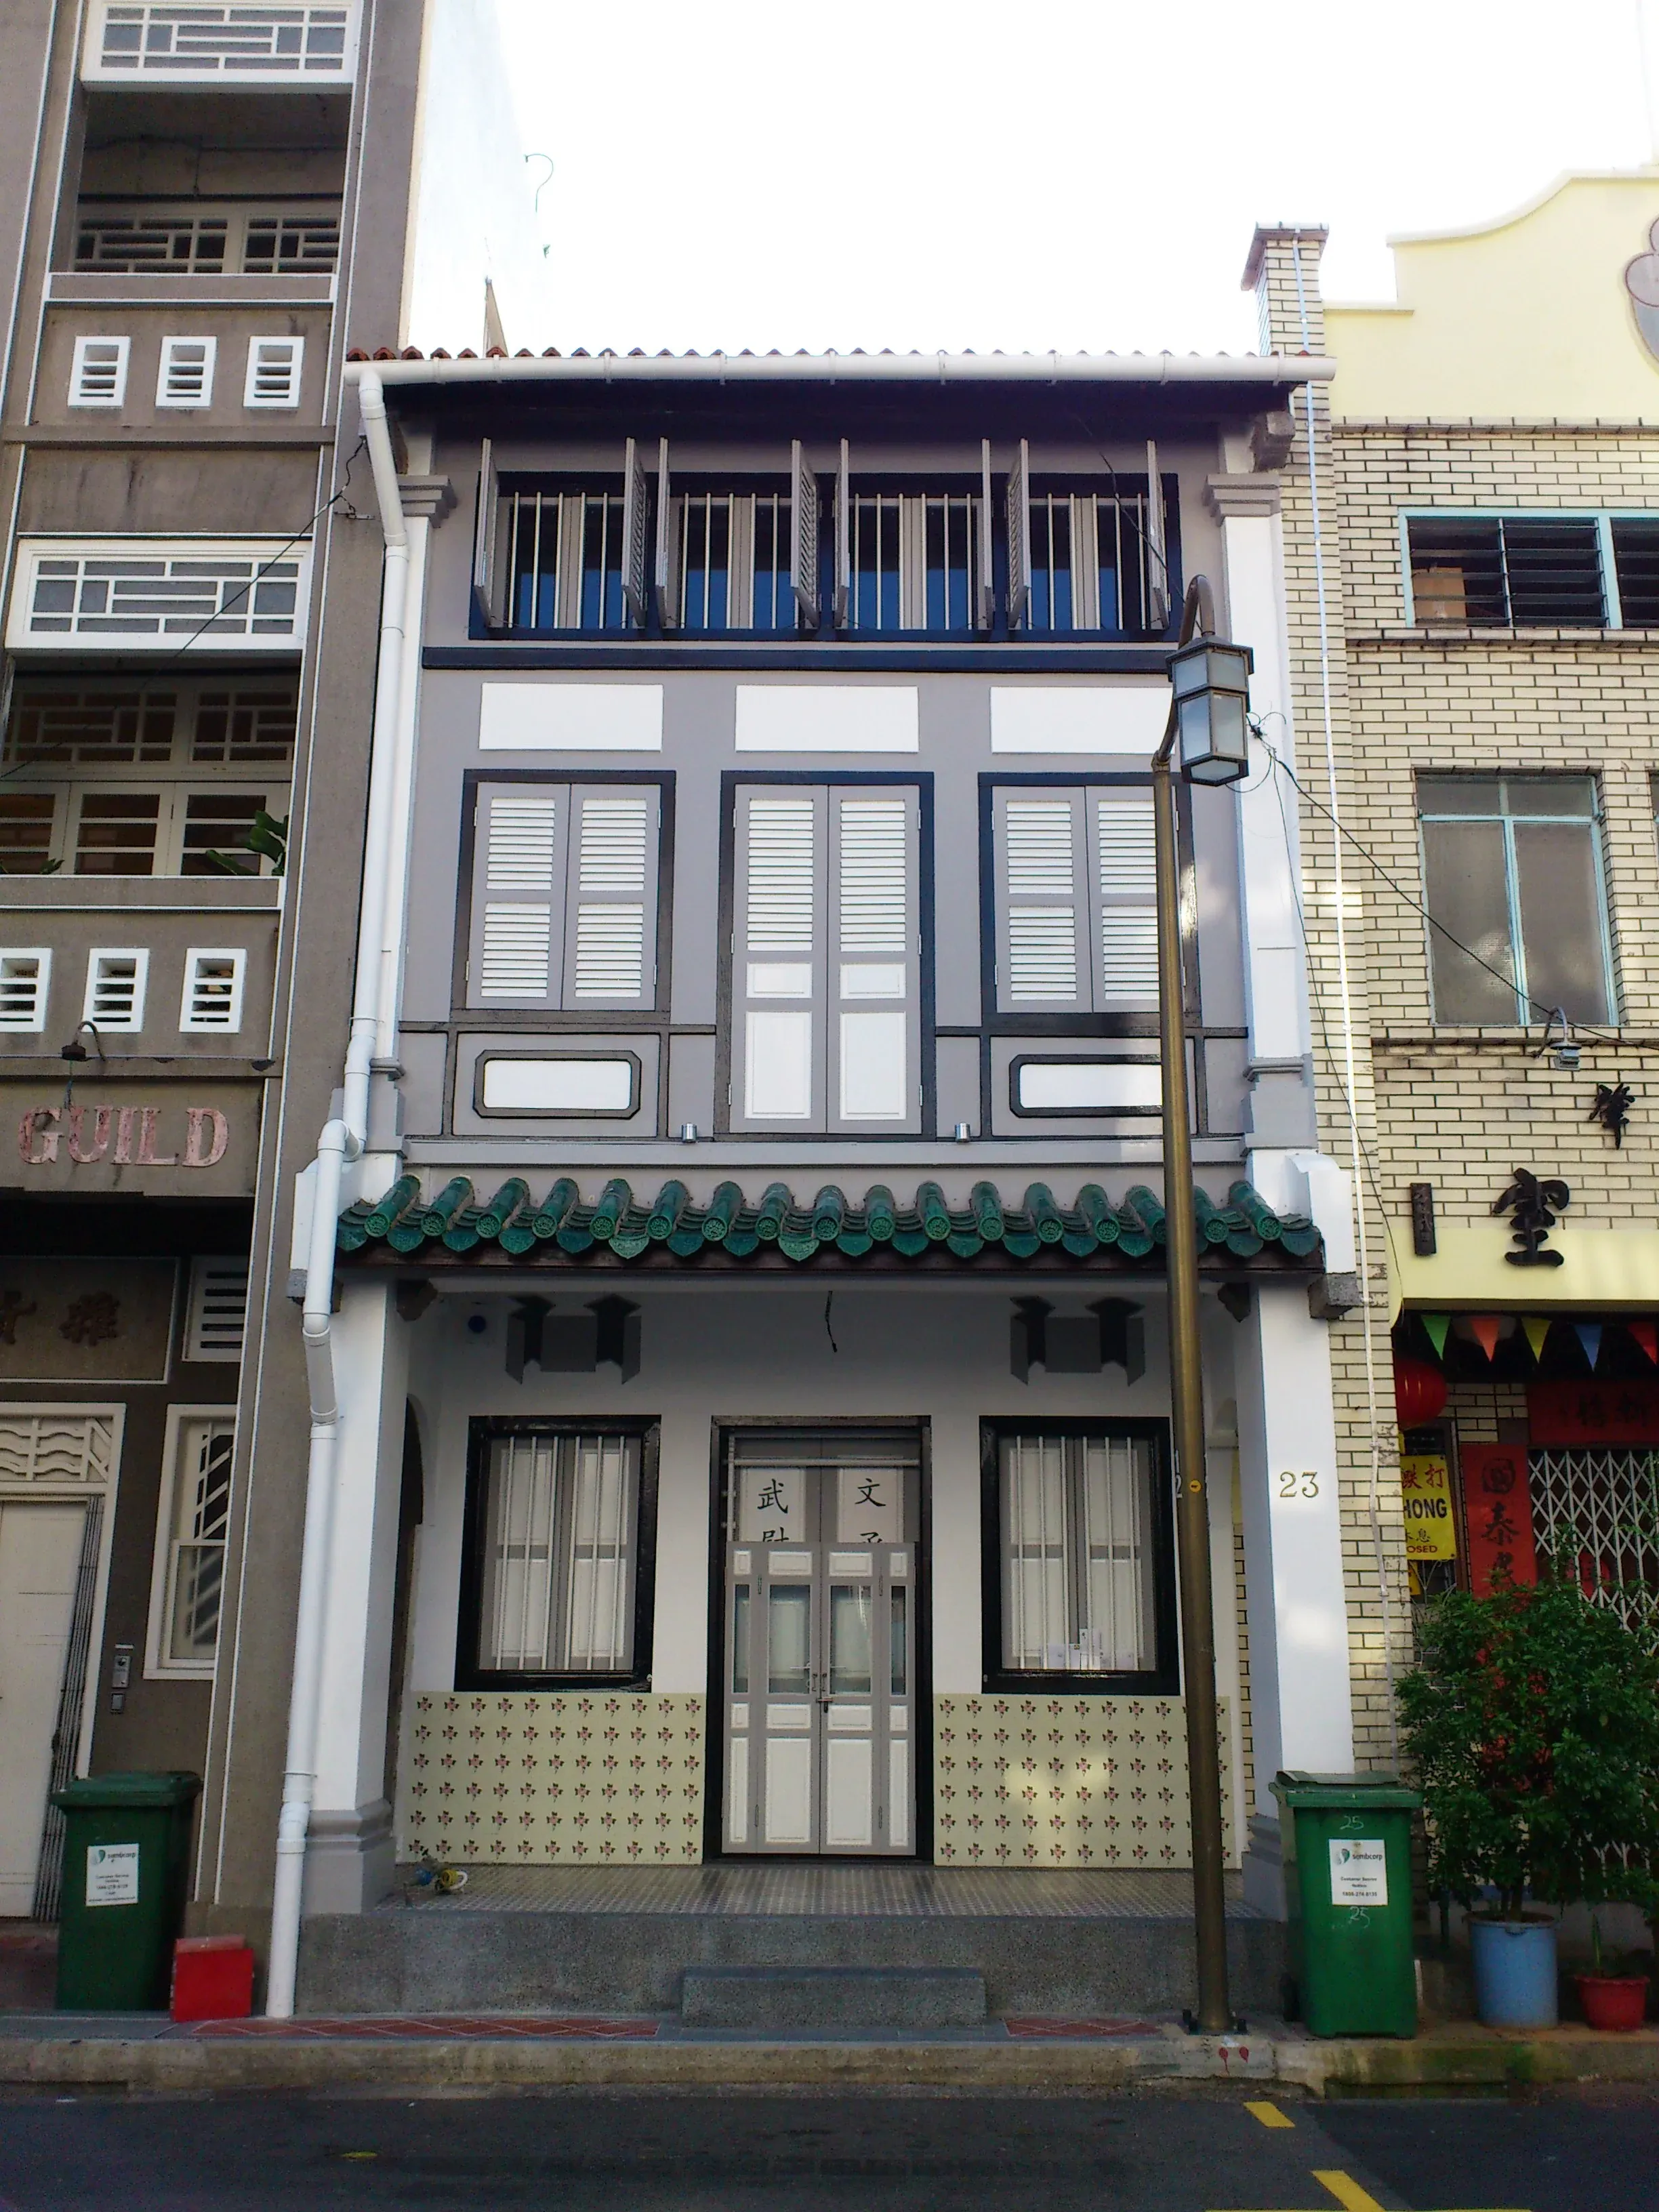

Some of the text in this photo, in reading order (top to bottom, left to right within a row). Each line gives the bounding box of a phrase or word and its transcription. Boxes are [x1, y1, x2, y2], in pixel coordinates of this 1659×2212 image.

[18, 1105, 230, 1167] GUILD
[1279, 1470, 1319, 1498] 23
[1339, 1815, 1364, 1830] 25
[1352, 1852, 1383, 1862] sembcorp
[1349, 1906, 1371, 1929] 25
